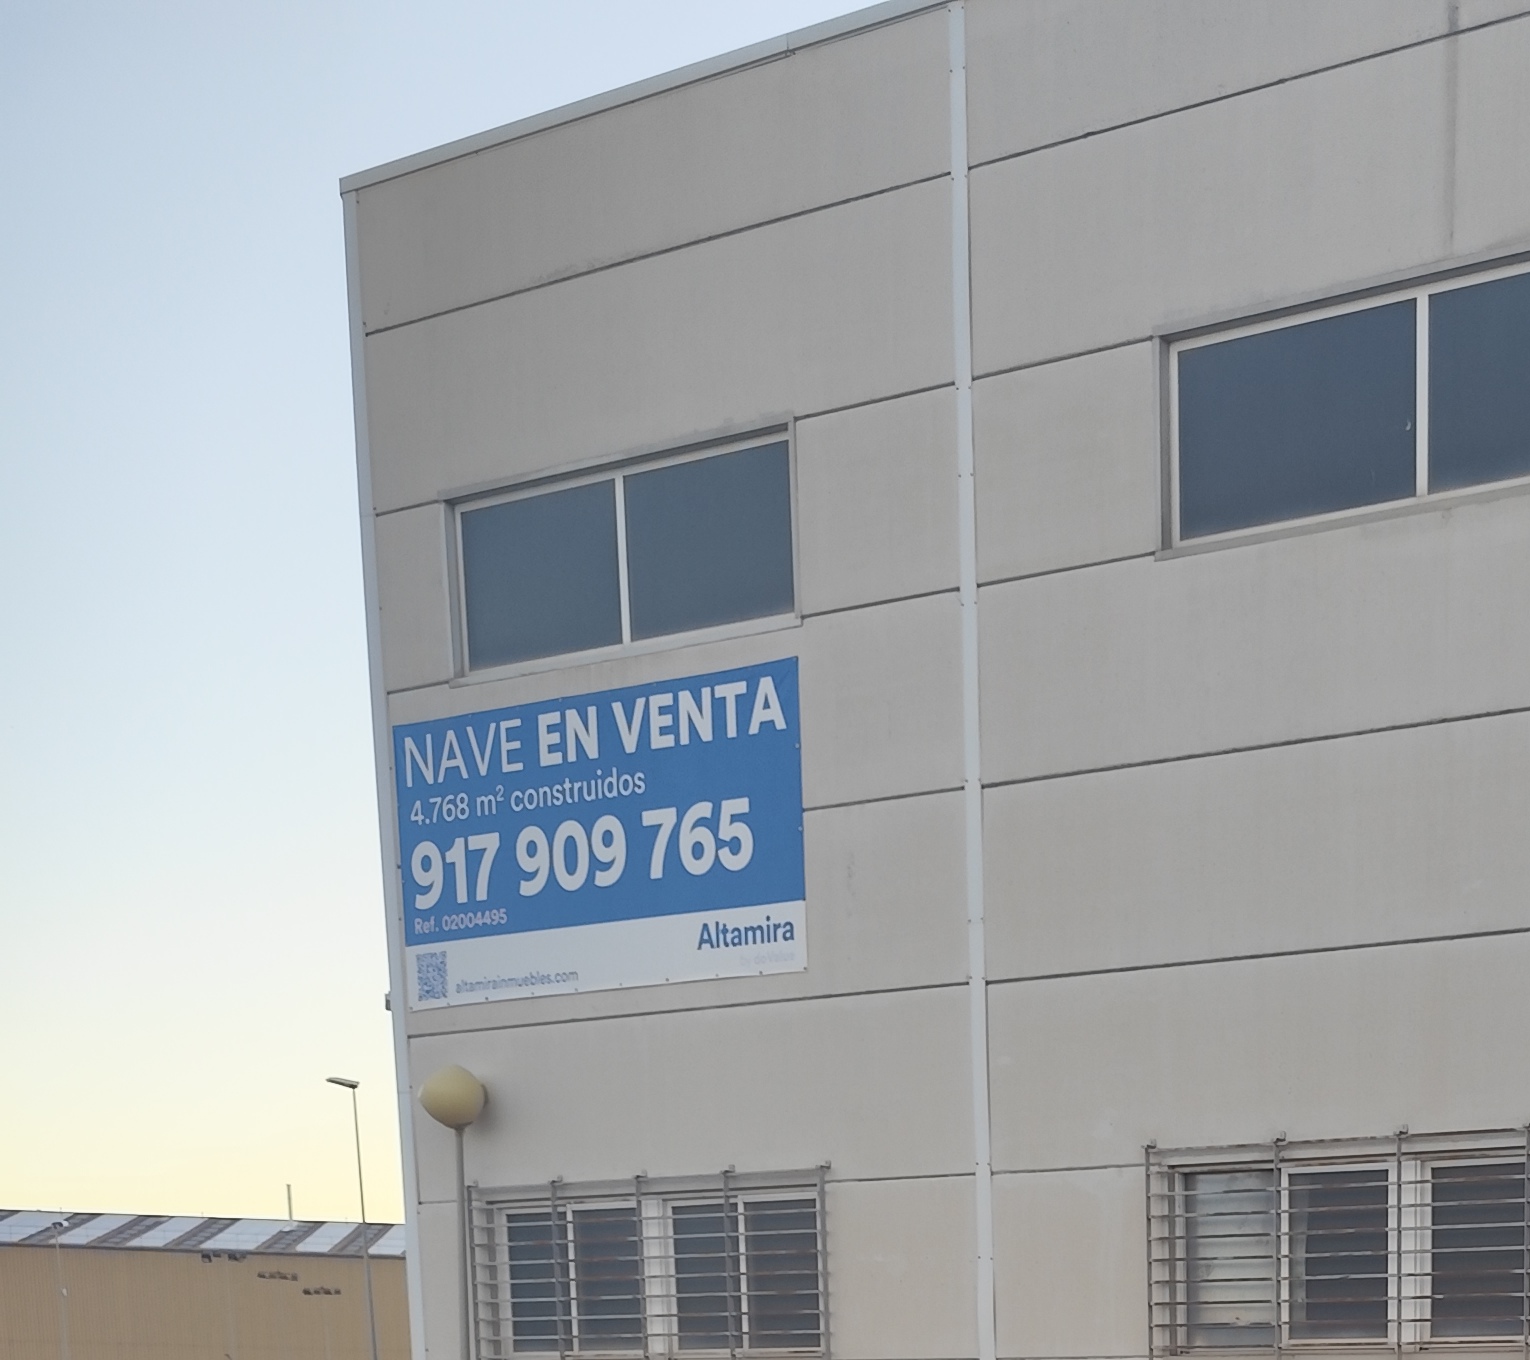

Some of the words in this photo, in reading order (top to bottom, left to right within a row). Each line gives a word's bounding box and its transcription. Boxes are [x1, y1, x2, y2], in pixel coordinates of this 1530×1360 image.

[404, 718, 524, 788] NAVE
[537, 705, 599, 767] EN
[611, 676, 787, 754] VENTA
[410, 792, 469, 826] 4.768
[476, 785, 504, 816] m²
[510, 766, 646, 812] construidos
[411, 832, 500, 910] 917
[515, 814, 627, 897] 909
[641, 797, 754, 880] 765
[414, 916, 439, 934] Ref.
[442, 908, 508, 931] 02004495
[697, 915, 796, 951] Altamira
[456, 970, 579, 994] altamirainmuebles.com
